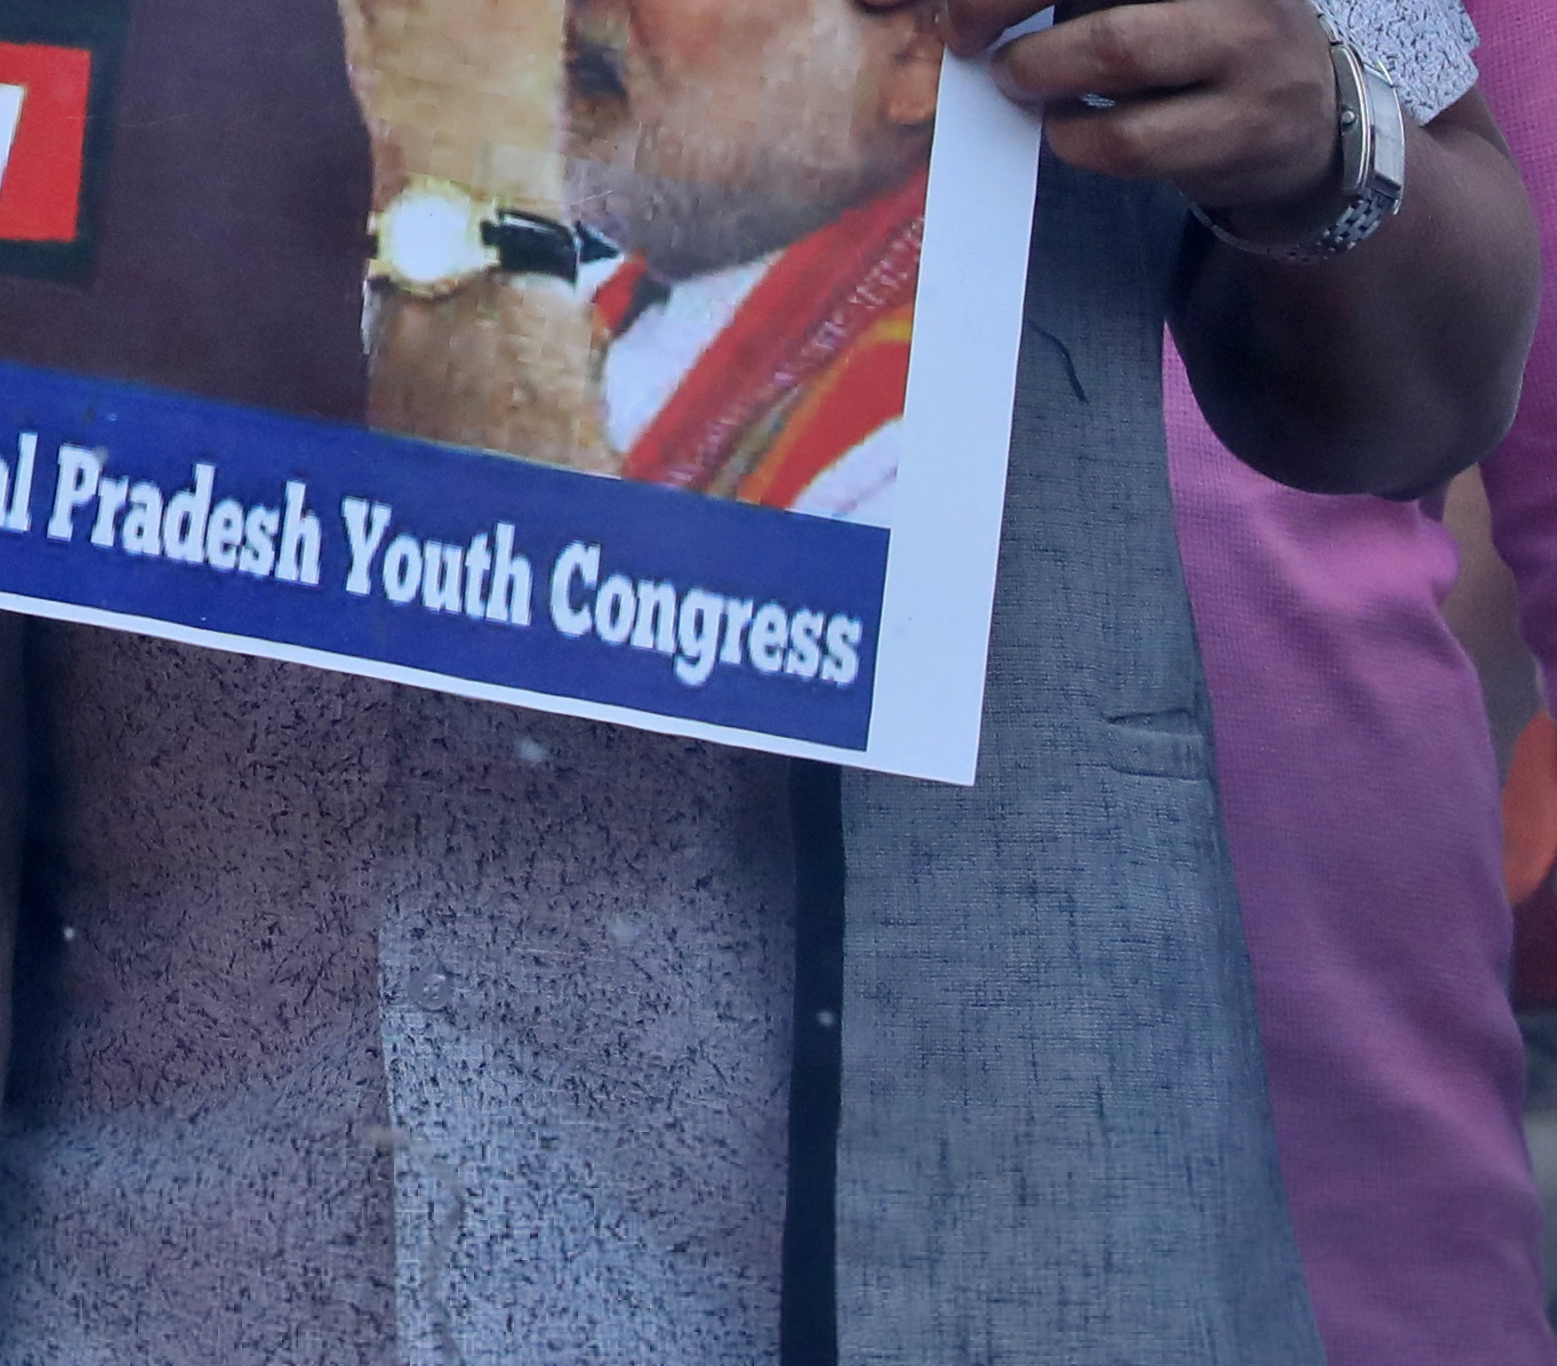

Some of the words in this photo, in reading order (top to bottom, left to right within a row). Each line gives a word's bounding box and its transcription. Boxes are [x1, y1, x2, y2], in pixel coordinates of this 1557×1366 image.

[48, 447, 320, 584] Pradesh
[344, 500, 531, 626] Youth
[551, 543, 861, 685] Congress
